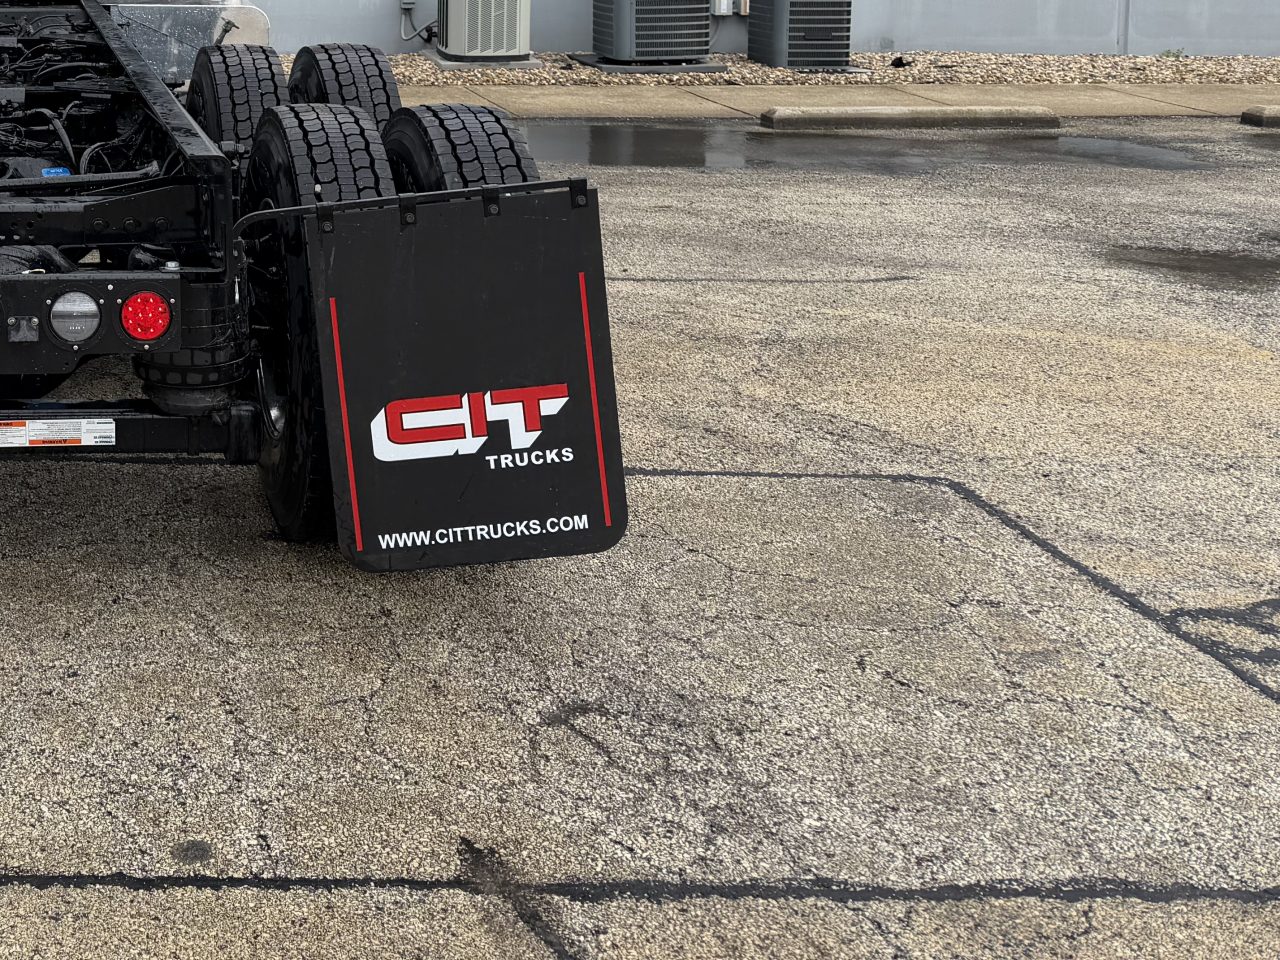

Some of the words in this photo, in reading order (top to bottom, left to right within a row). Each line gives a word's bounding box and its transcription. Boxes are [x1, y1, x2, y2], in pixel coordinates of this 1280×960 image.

[370, 383, 570, 462] CIT
[485, 447, 575, 470] TRUCKS
[378, 514, 589, 550] WWW.CITTRUCKS.COM
